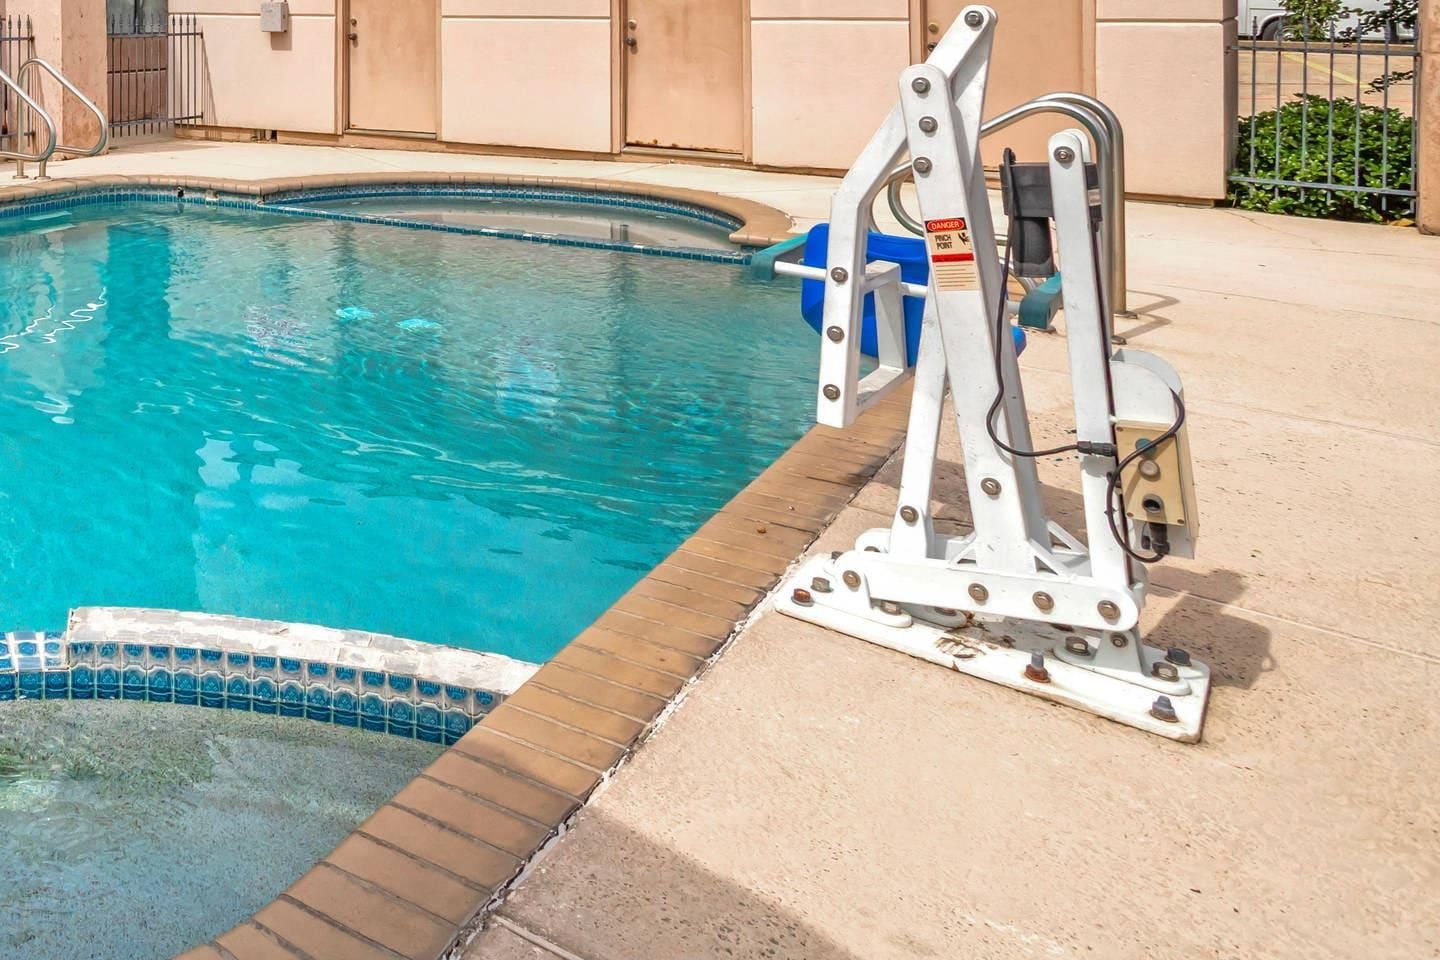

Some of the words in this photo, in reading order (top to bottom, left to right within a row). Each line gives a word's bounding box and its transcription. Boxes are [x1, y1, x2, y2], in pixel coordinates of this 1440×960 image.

[931, 221, 960, 230] DANGER
[935, 234, 951, 242] PINCH
[936, 242, 952, 250] POINT
